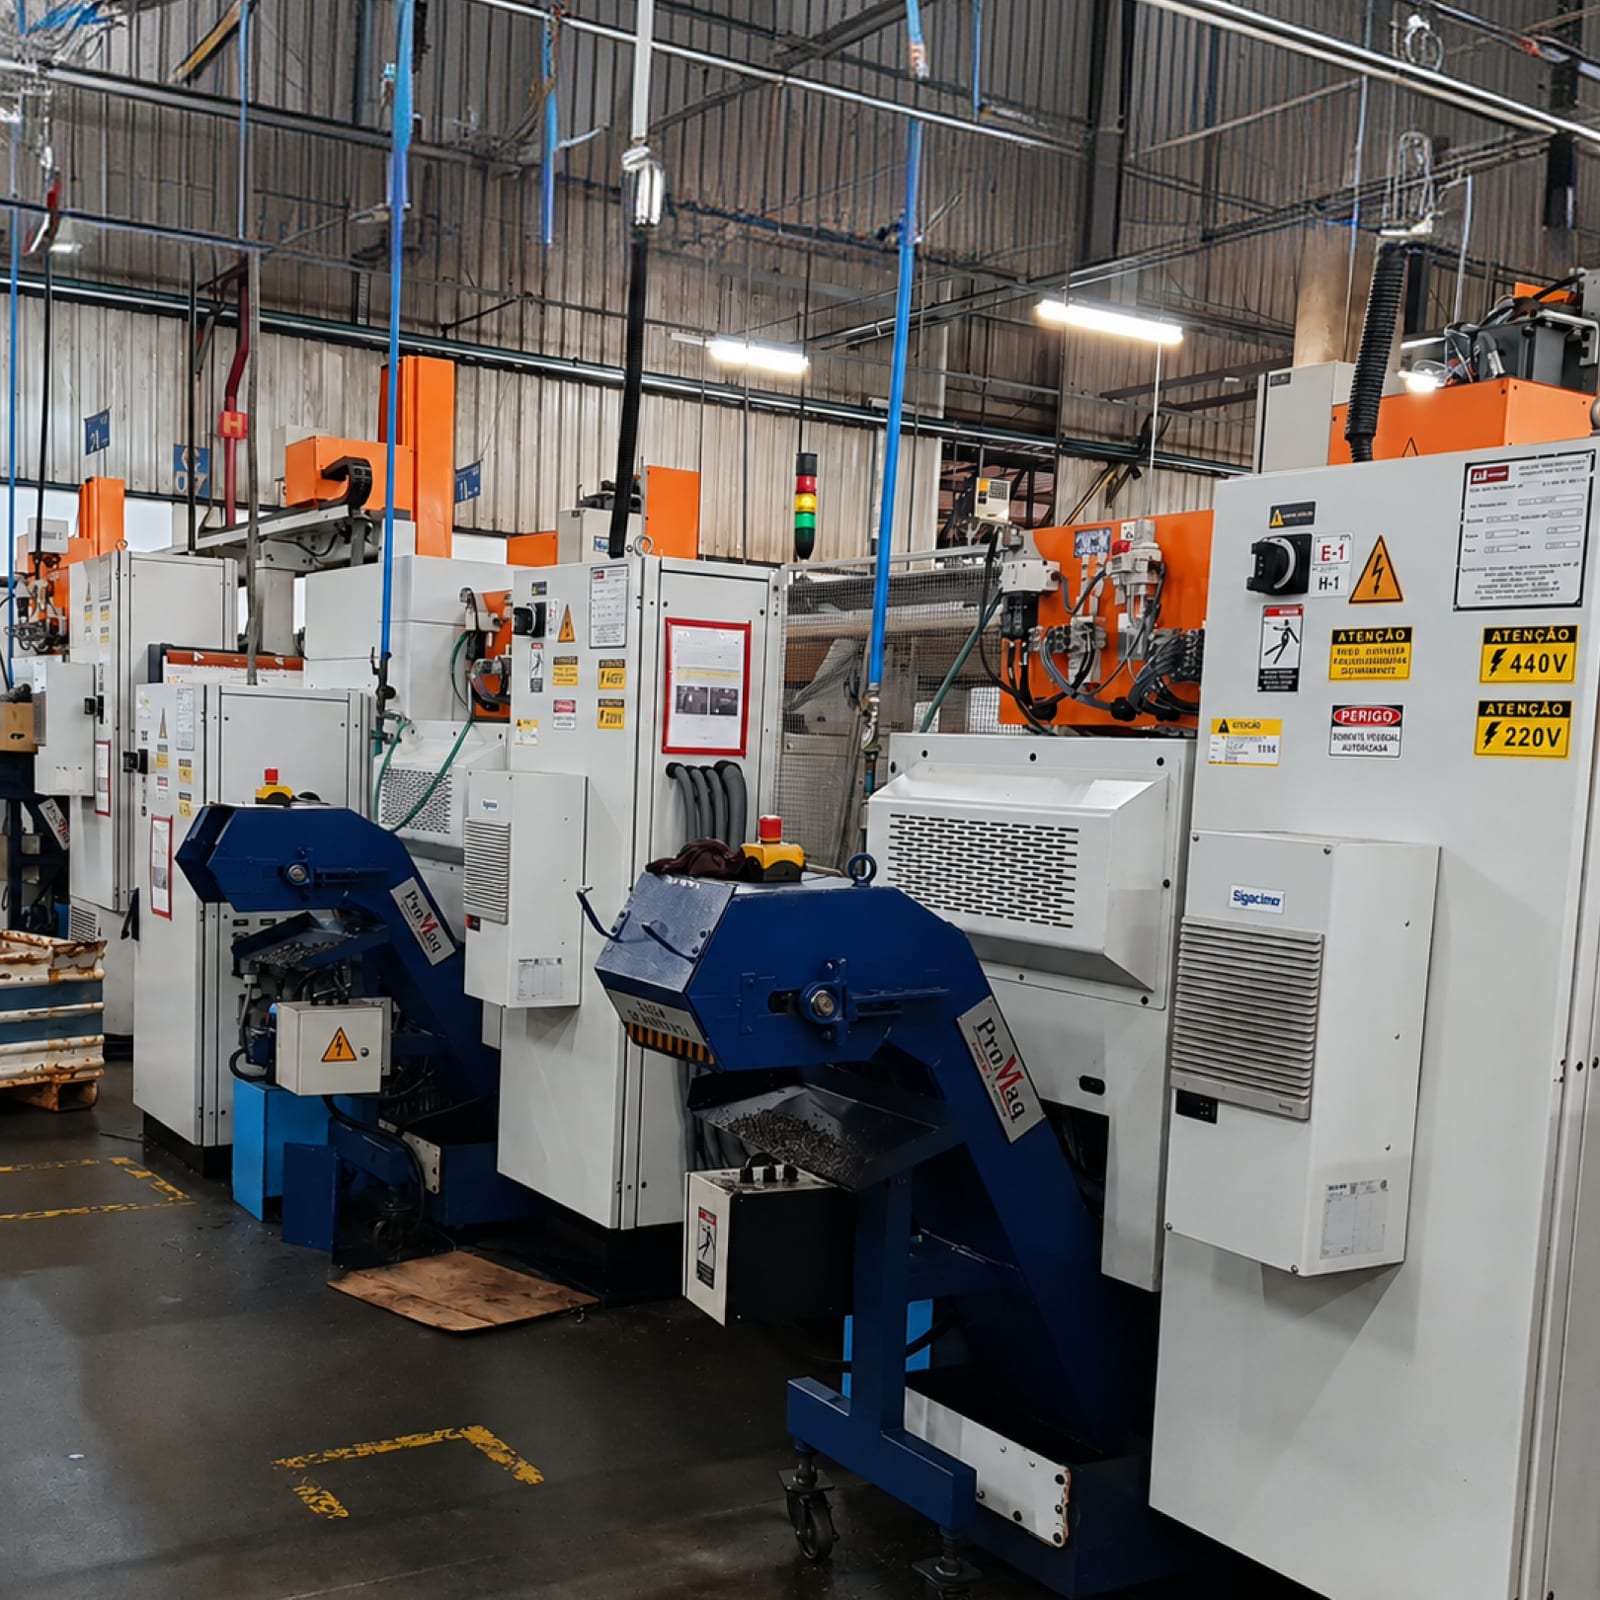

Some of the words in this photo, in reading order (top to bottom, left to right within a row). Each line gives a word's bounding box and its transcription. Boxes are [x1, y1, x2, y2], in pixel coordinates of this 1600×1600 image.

[223, 411, 243, 438] H
[1321, 543, 1344, 562] E-1
[1318, 575, 1339, 591] H-1
[1337, 627, 1406, 644] ATENÇÃO
[1491, 626, 1570, 644] ATENÇÃO
[1509, 652, 1568, 674] 440V
[1341, 709, 1393, 723] PERIGO
[1485, 700, 1564, 717] ATENÇÃO
[1503, 726, 1562, 748] 220V
[976, 1016, 1025, 1124] ProMaq
